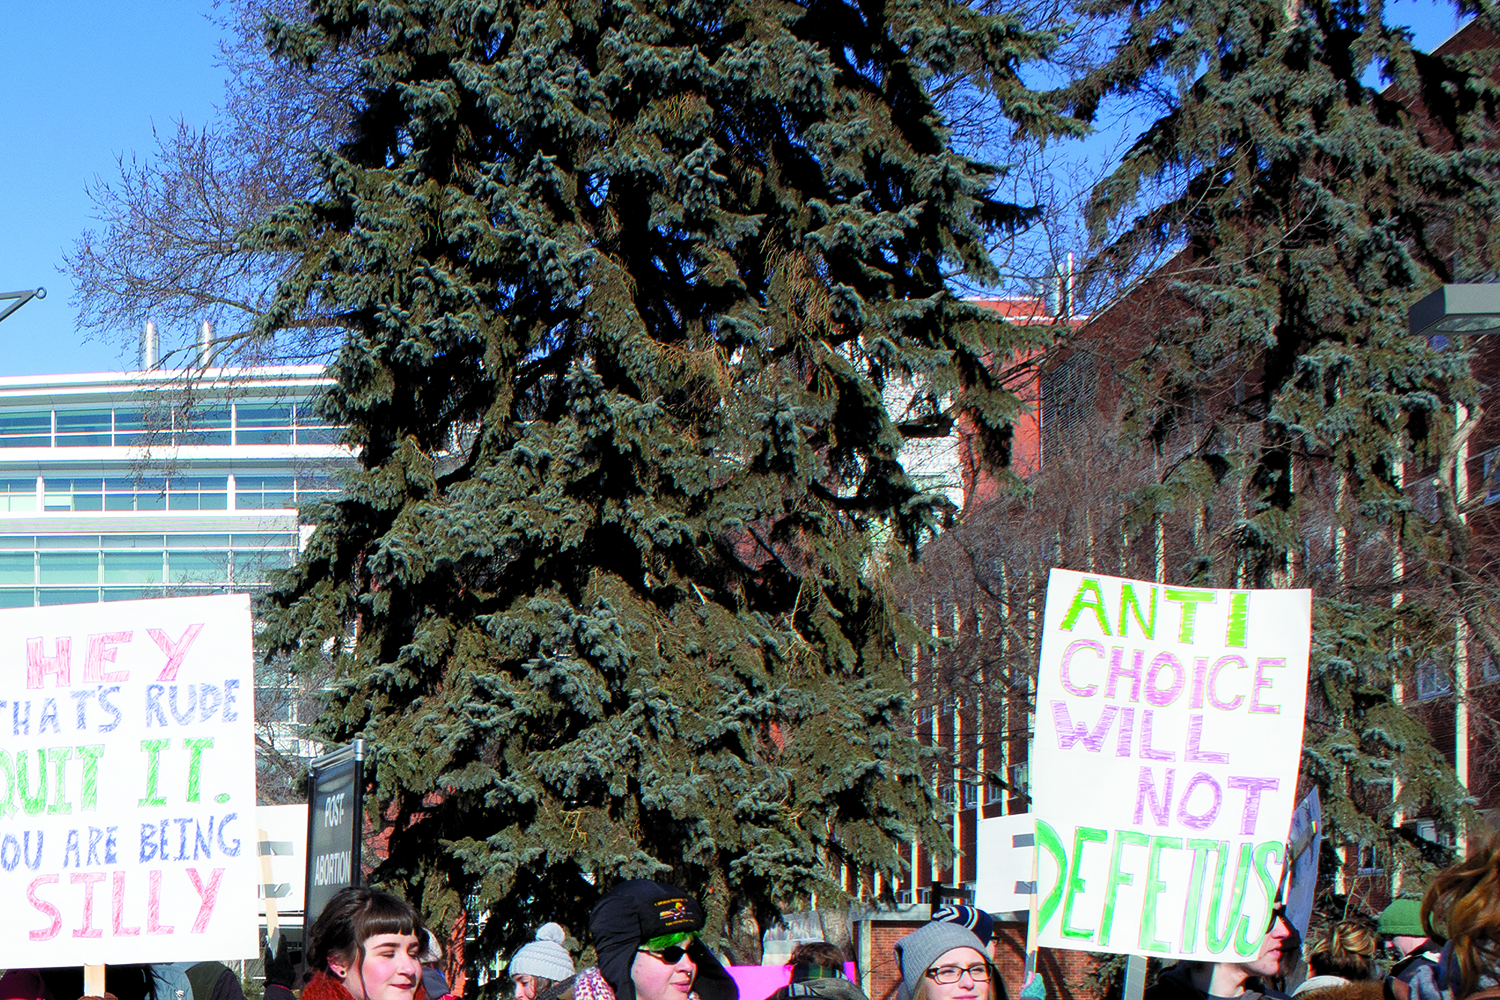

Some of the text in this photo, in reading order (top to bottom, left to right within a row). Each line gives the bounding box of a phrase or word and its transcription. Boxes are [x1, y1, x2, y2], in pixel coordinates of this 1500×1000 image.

[1059, 576, 1252, 649] ANTI
[26, 623, 206, 690] HEY
[1060, 639, 1287, 715] CHOICE
[145, 680, 240, 728] RUDE
[1050, 700, 1230, 765] WILL
[137, 737, 231, 807] IT.
[1132, 766, 1281, 836] NOT
[63, 826, 120, 868] ARE
[138, 812, 241, 864] BEING
[314, 851, 350, 886] ABORTION
[26, 868, 225, 942] SILLY
